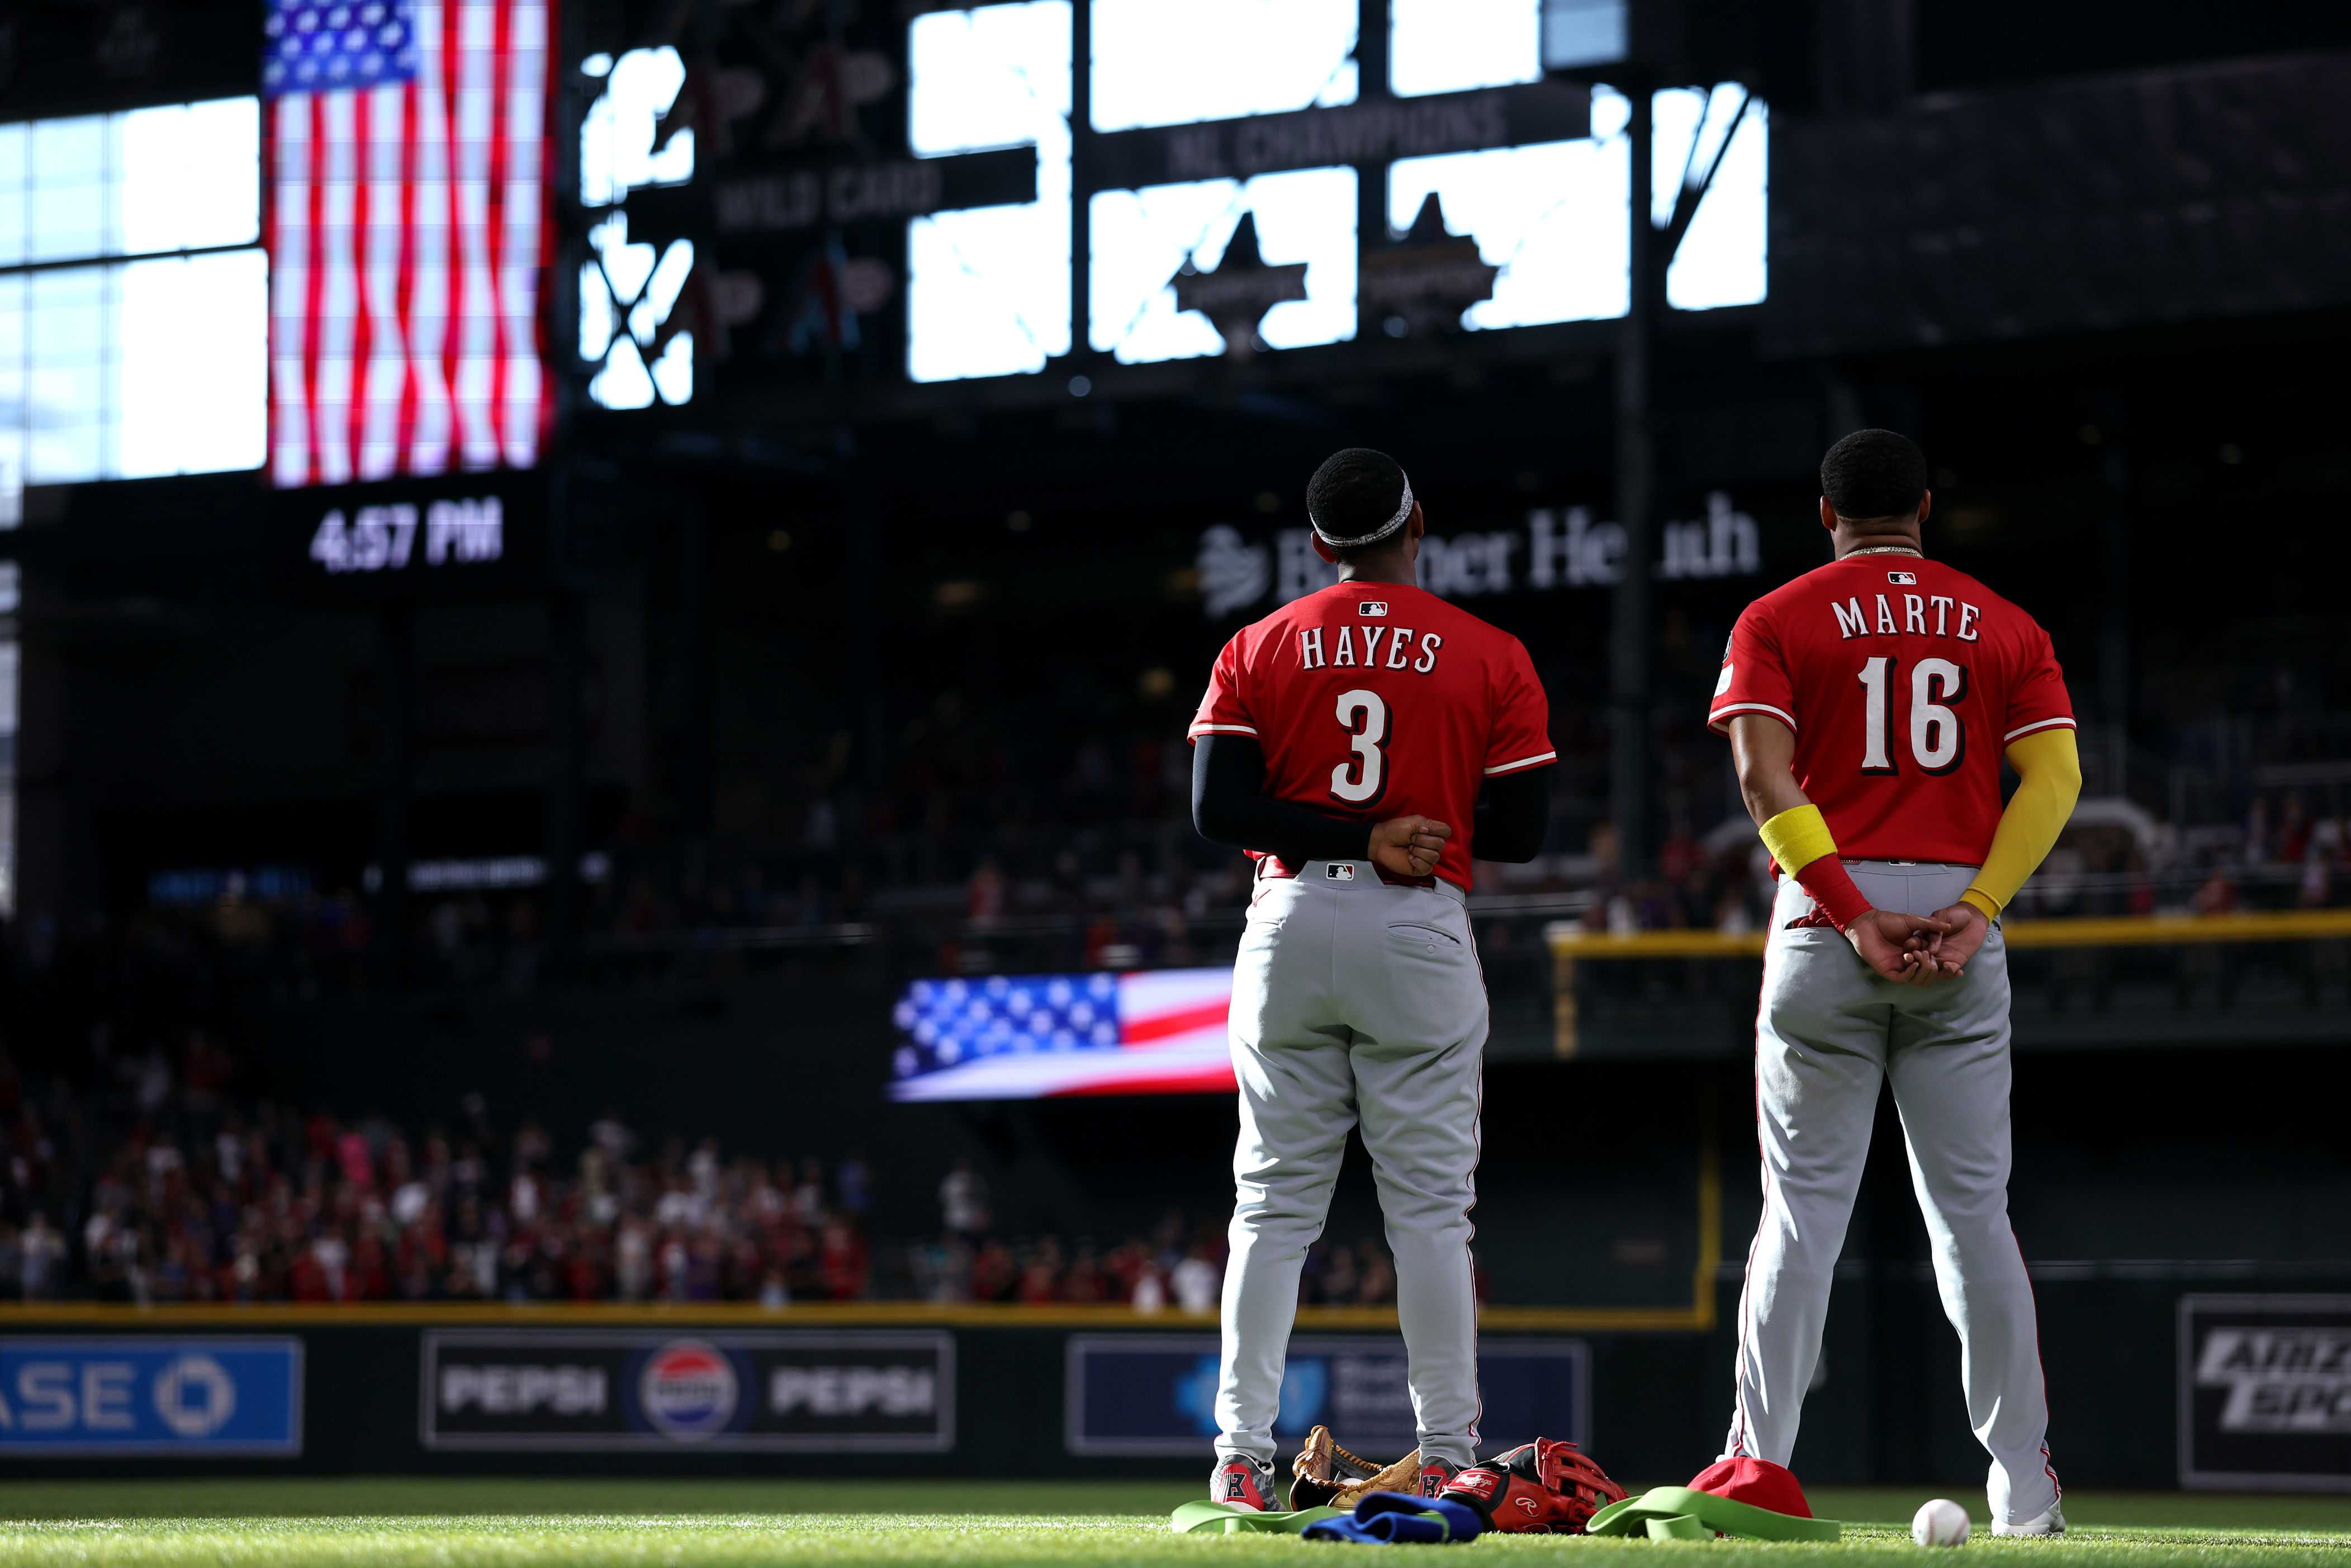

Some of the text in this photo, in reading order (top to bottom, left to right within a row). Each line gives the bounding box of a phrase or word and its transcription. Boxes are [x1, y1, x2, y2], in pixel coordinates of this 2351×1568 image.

[309, 495, 503, 575] 4:57 PM
[1272, 525, 1521, 607] Bner
[1831, 593, 1981, 643] MARTE
[1300, 626, 1444, 675] HAYES
[1856, 655, 1968, 776] 16
[1328, 689, 1392, 809] 3
[0, 1360, 138, 1429] SE
[440, 1363, 608, 1416] PEPSI
[770, 1364, 935, 1417] PEPSI
[1455, 1474, 1493, 1488] Rawlings
